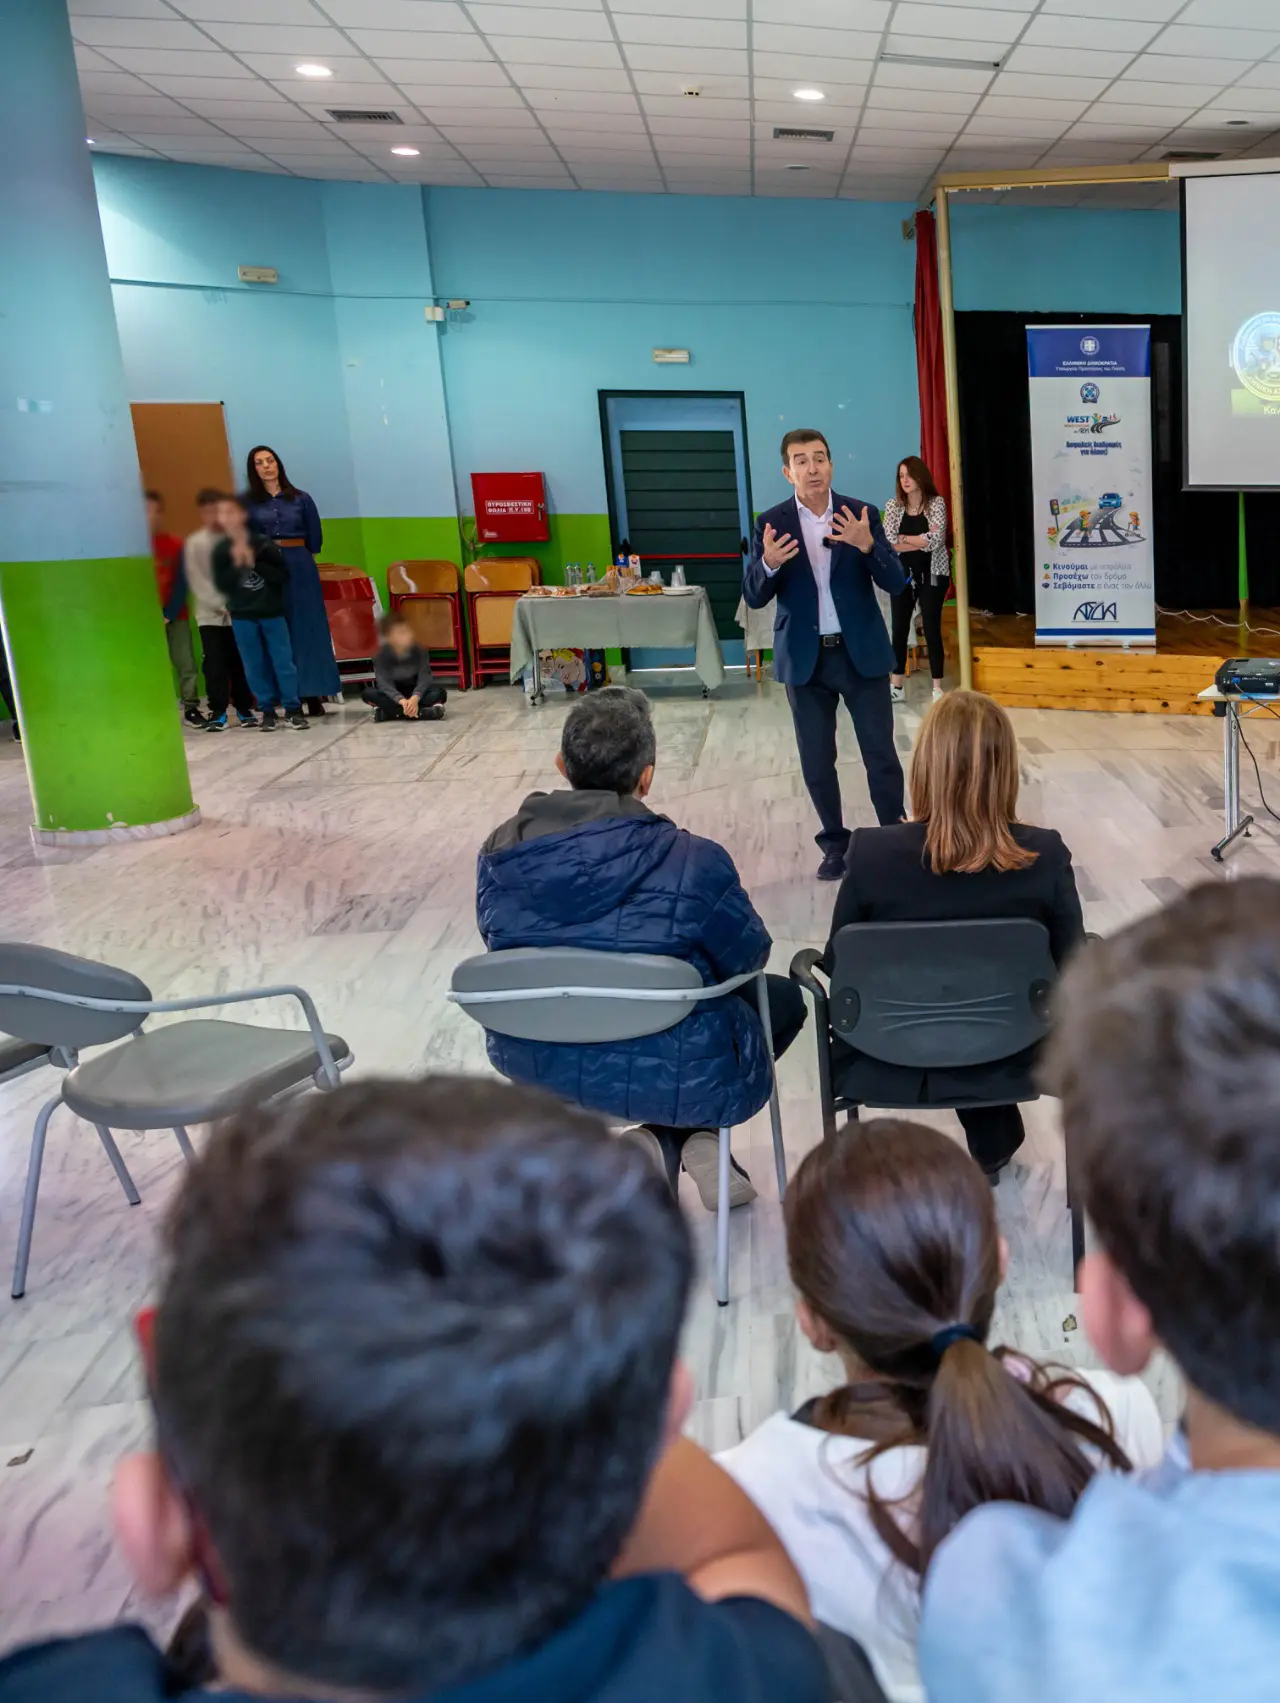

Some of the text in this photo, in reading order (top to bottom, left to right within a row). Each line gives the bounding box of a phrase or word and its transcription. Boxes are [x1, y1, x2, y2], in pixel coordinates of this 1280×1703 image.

[1067, 415, 1090, 423] WEST
[1053, 563, 1088, 571] Κινούμαι
[1053, 572, 1089, 581] Προσέχω
[1053, 582, 1096, 591] Σεβόμαστε
